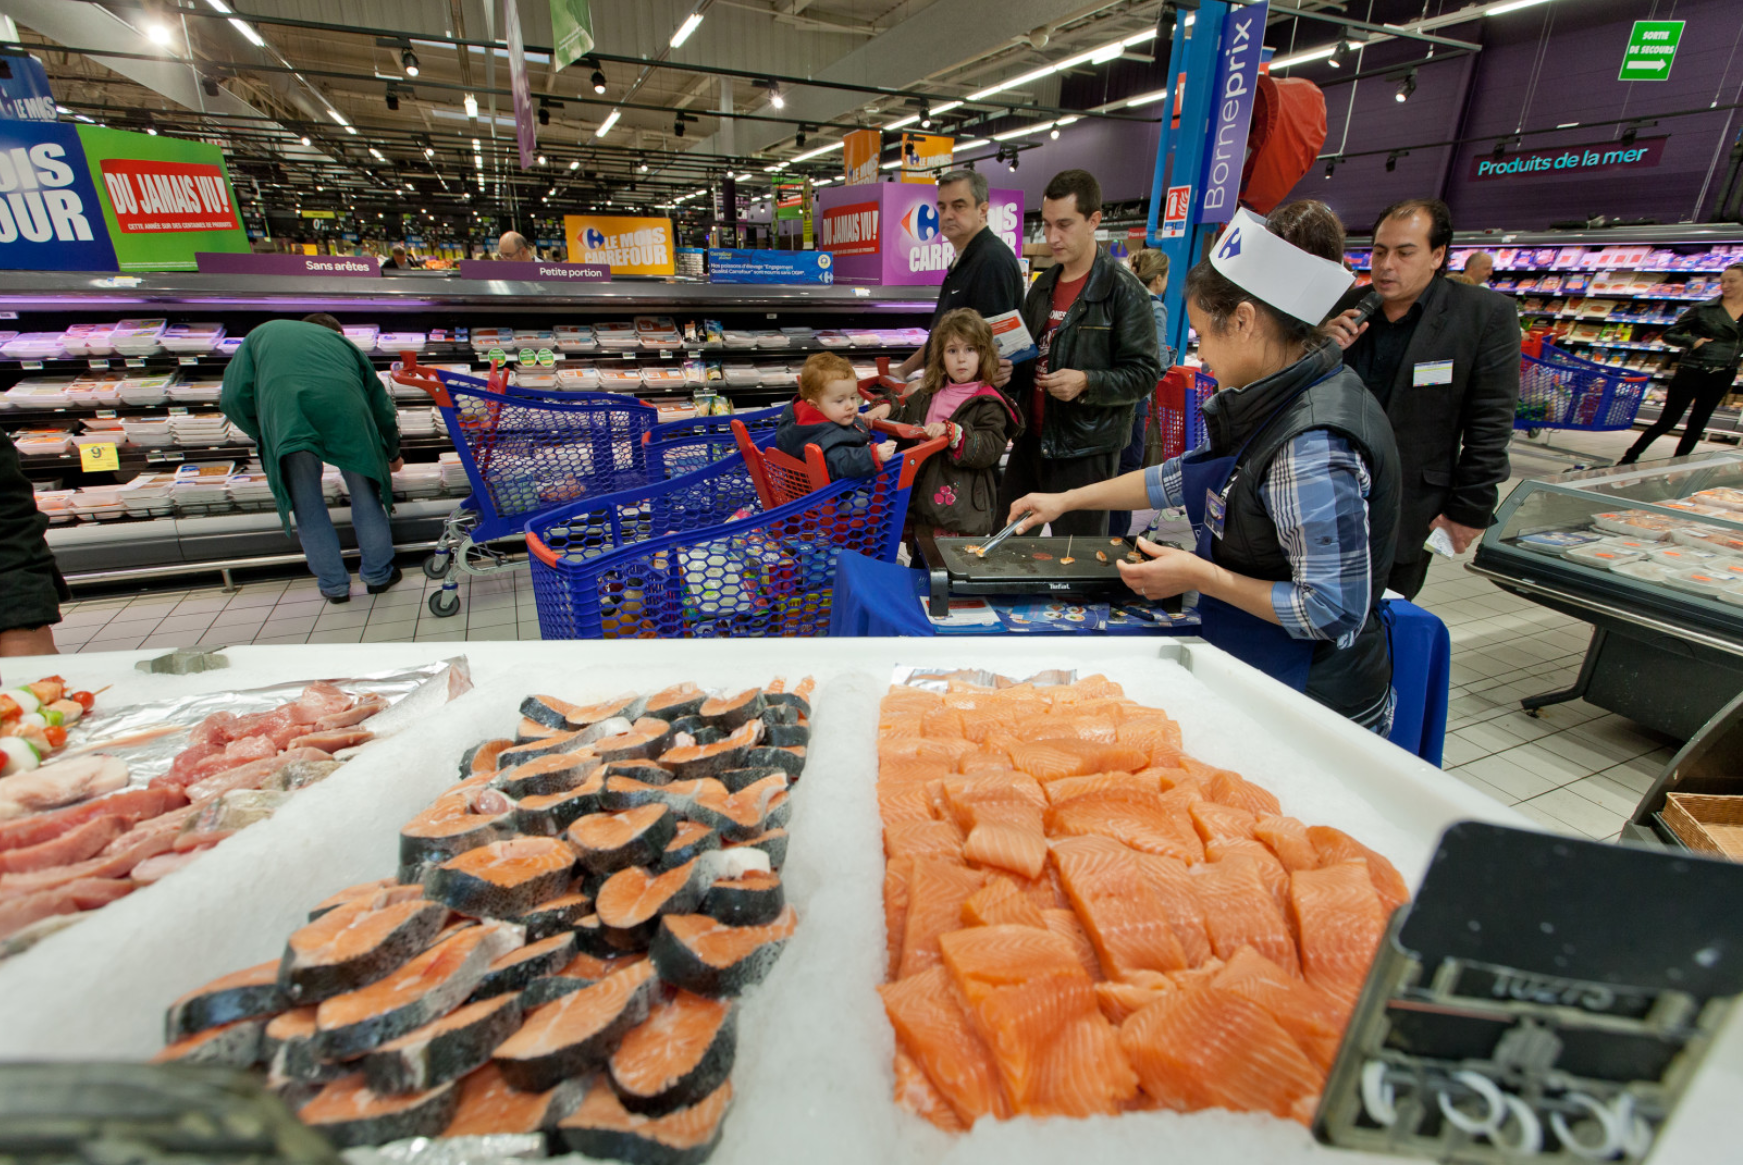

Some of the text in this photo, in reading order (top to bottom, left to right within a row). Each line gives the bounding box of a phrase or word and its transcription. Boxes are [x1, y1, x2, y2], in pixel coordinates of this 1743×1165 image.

[1642, 31, 1670, 40] SORTIE
[1629, 45, 1675, 54] DE SECOURS
[1477, 147, 1649, 177] Produits de la mer
[104, 172, 139, 215] DU
[136, 173, 202, 215] JAMAIS
[604, 226, 667, 250] LE MOIS
[822, 217, 833, 245] DU
[832, 212, 860, 245] JAMAIS
[305, 260, 370, 272] Sans arêtes
[584, 244, 669, 266] CARREFOUR
[539, 267, 603, 279] Petite portion
